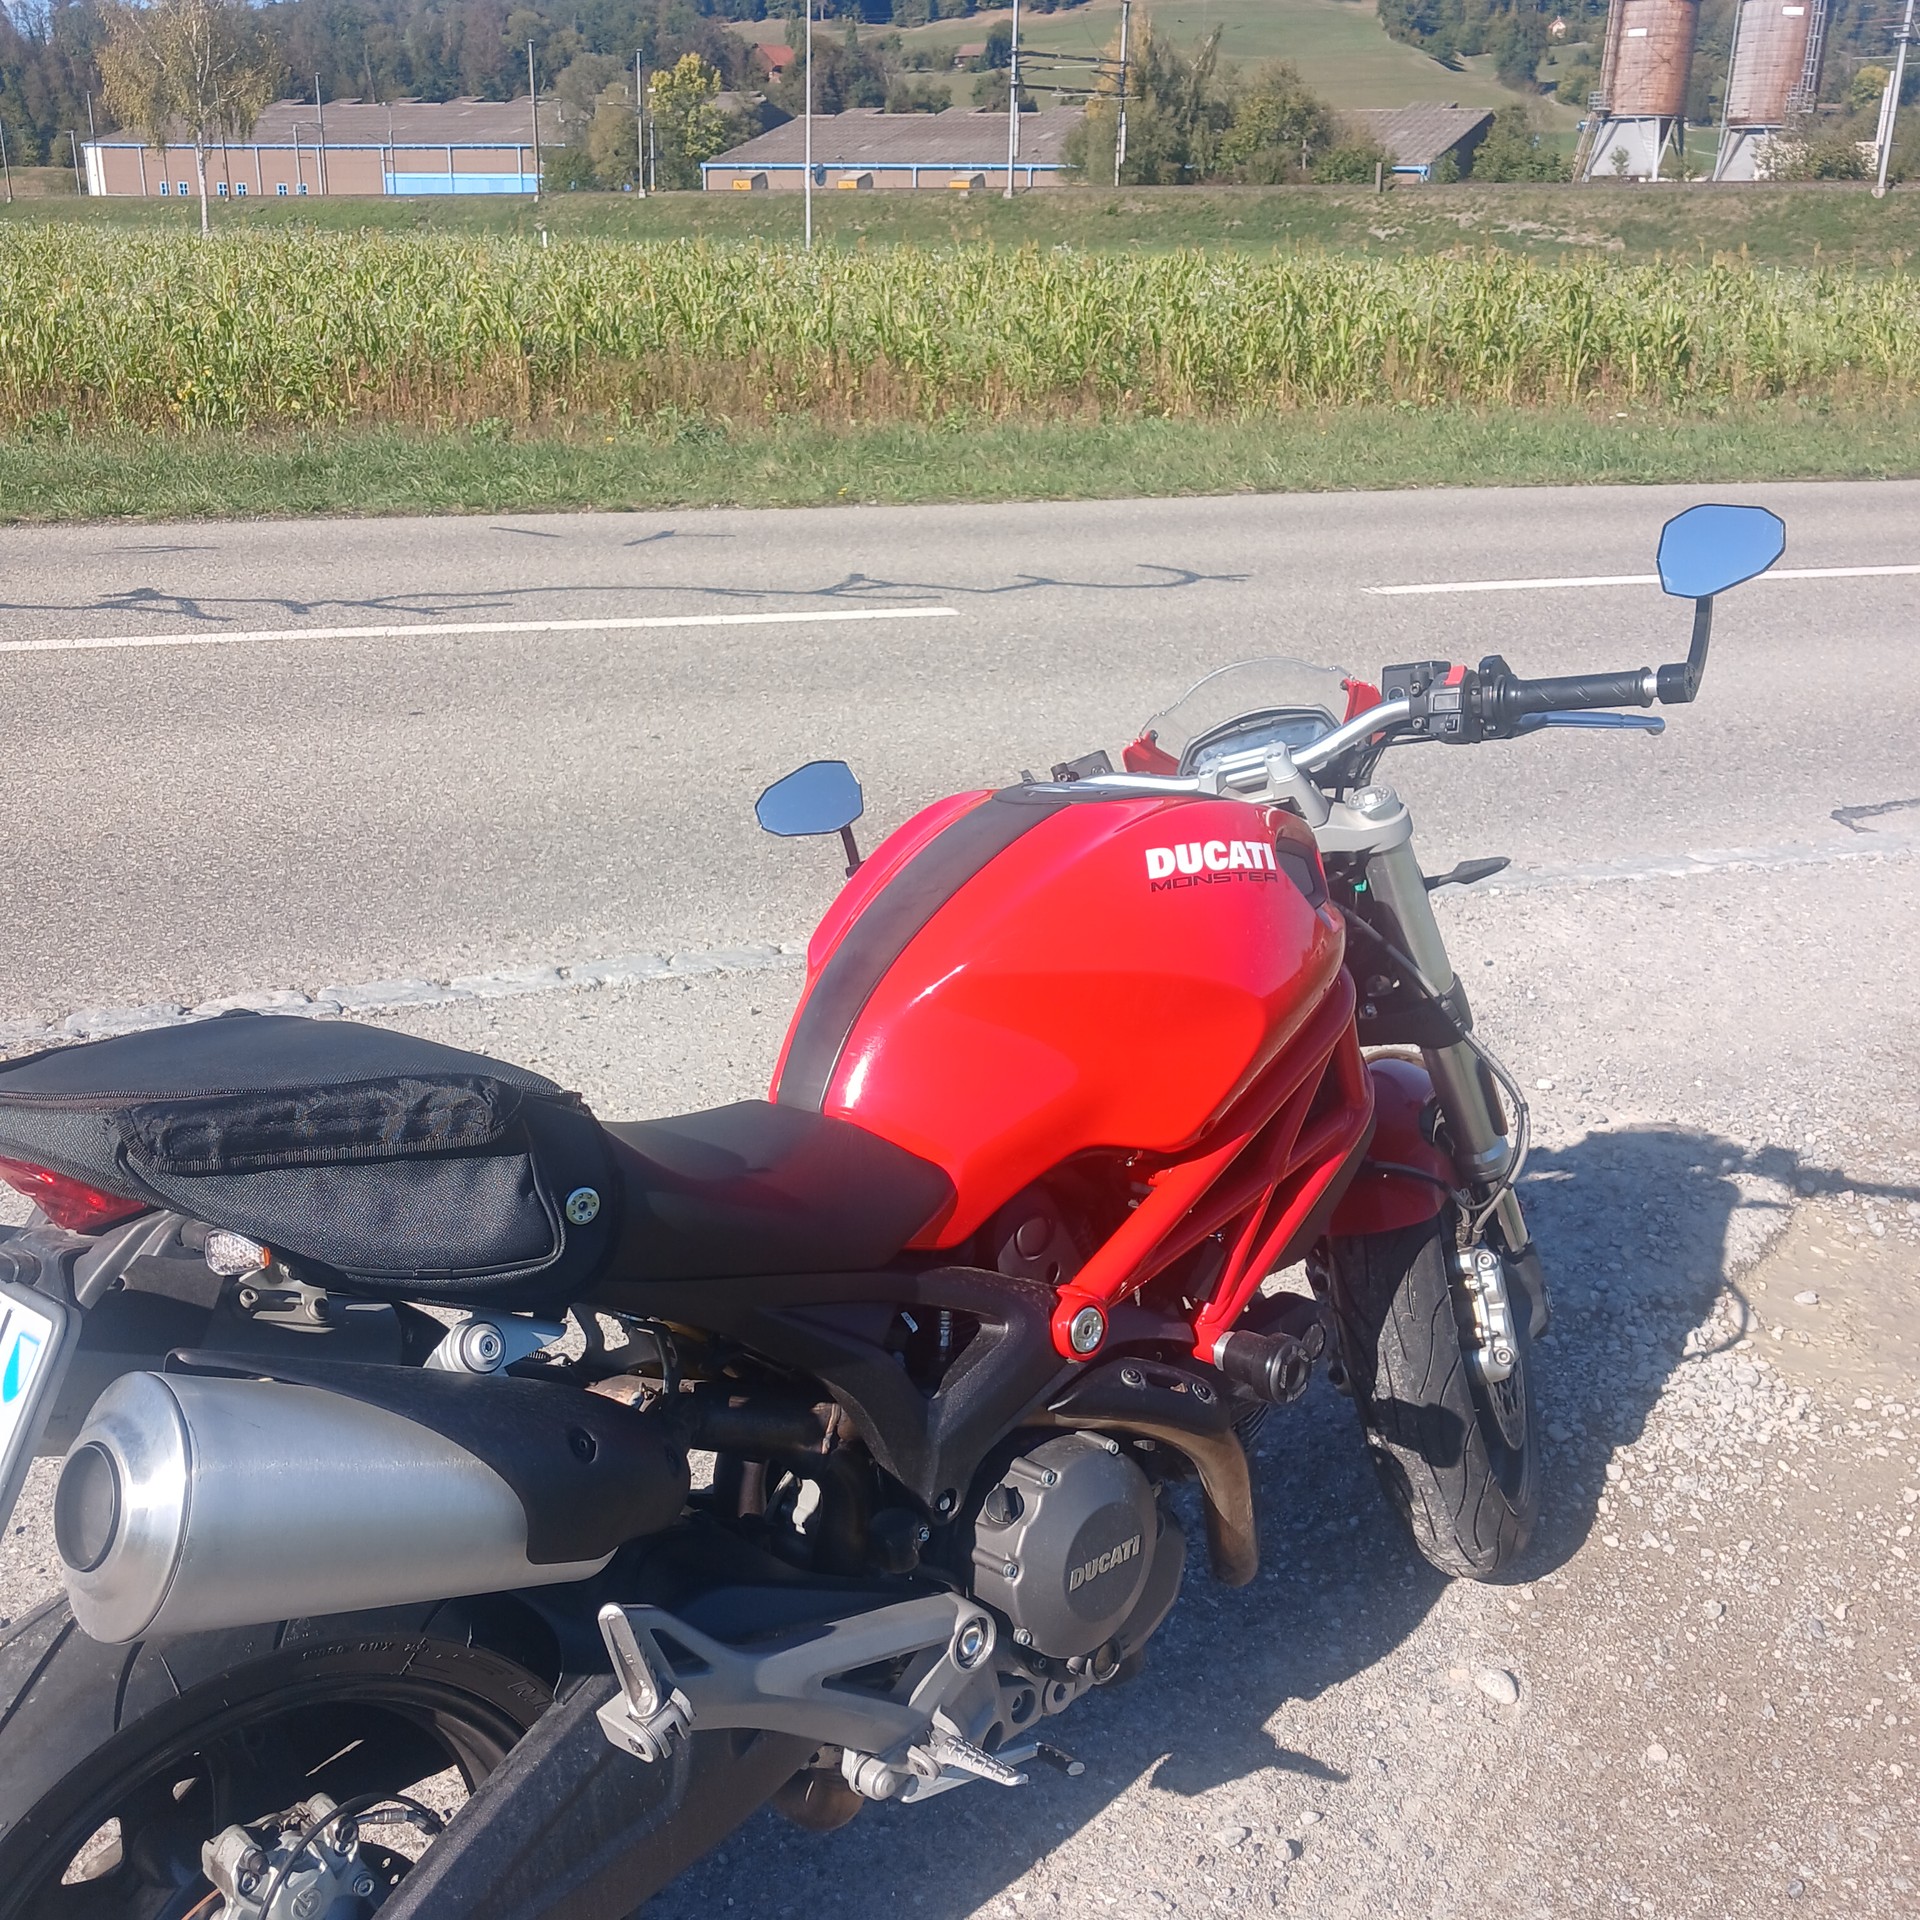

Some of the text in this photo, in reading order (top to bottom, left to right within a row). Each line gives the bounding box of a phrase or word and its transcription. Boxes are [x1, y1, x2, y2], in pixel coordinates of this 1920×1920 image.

[1145, 840, 1277, 879] DUCATI
[1151, 871, 1278, 892] MONSTER
[1069, 1534, 1141, 1592] DUCATI
